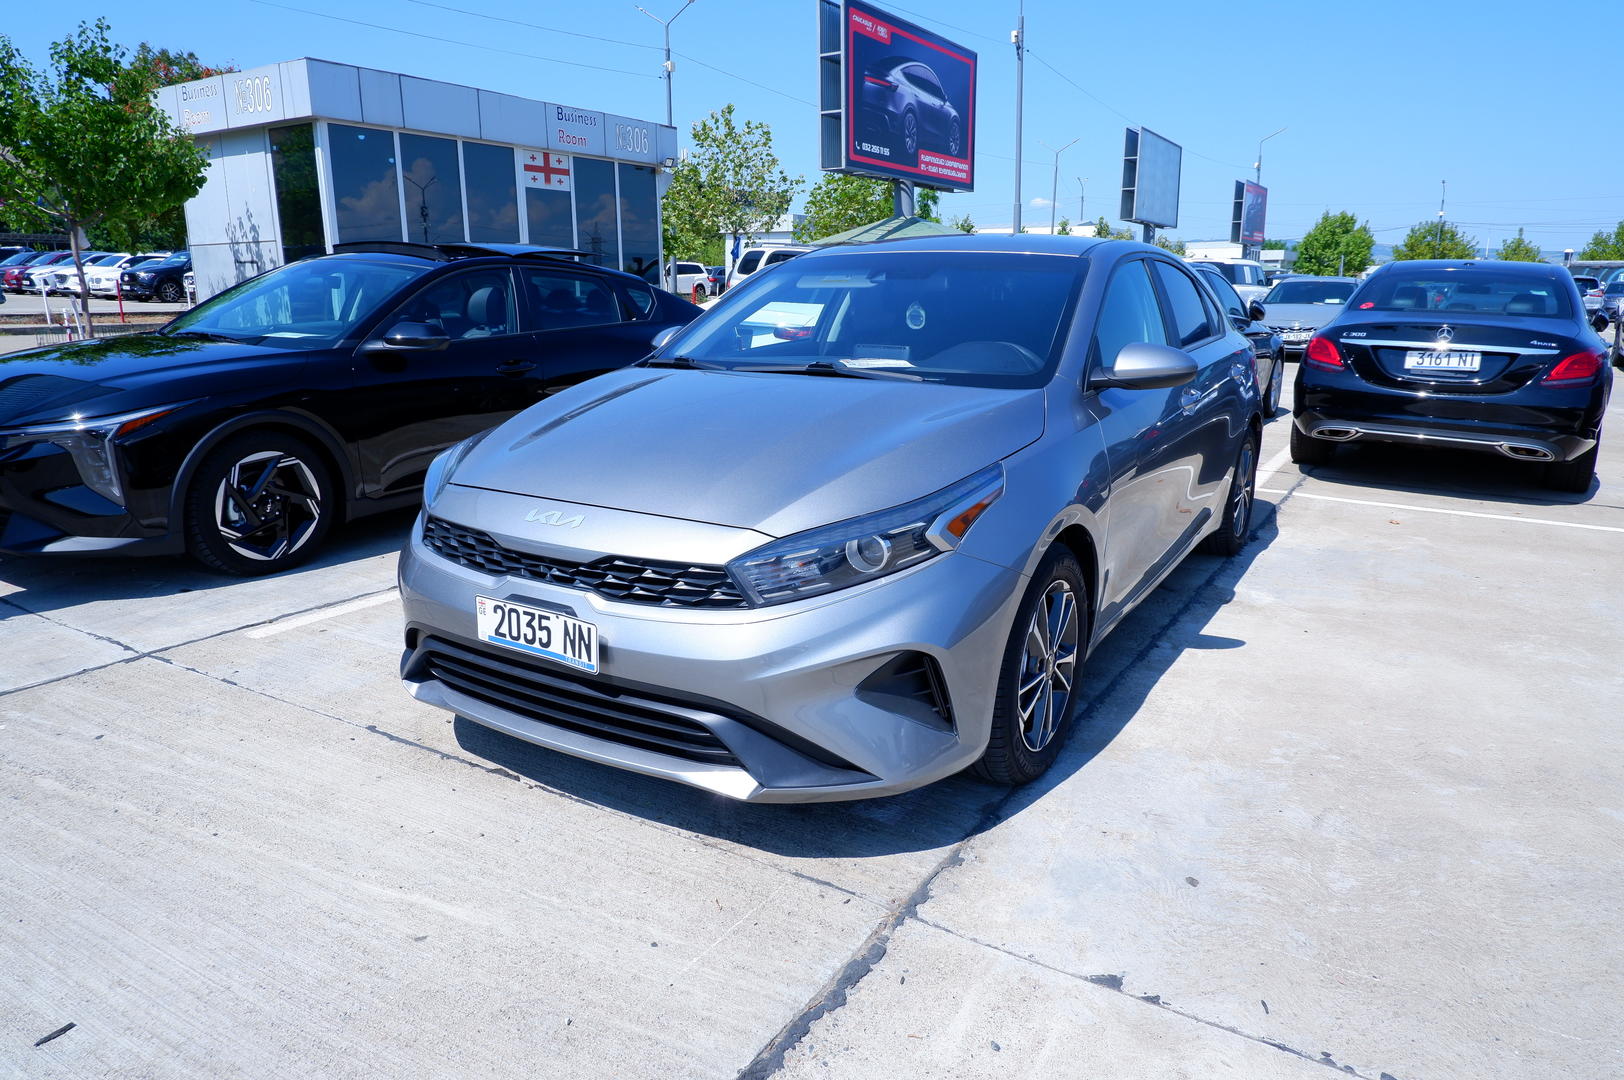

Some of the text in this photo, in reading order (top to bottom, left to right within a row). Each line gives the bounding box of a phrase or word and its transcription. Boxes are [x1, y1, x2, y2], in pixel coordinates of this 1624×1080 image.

[181, 84, 218, 101] Business
[556, 106, 597, 127] Business
[558, 129, 587, 147] Room
[1416, 352, 1475, 367] 3161 NI
[524, 509, 586, 529] KIA
[493, 604, 592, 662] 2035 NN
